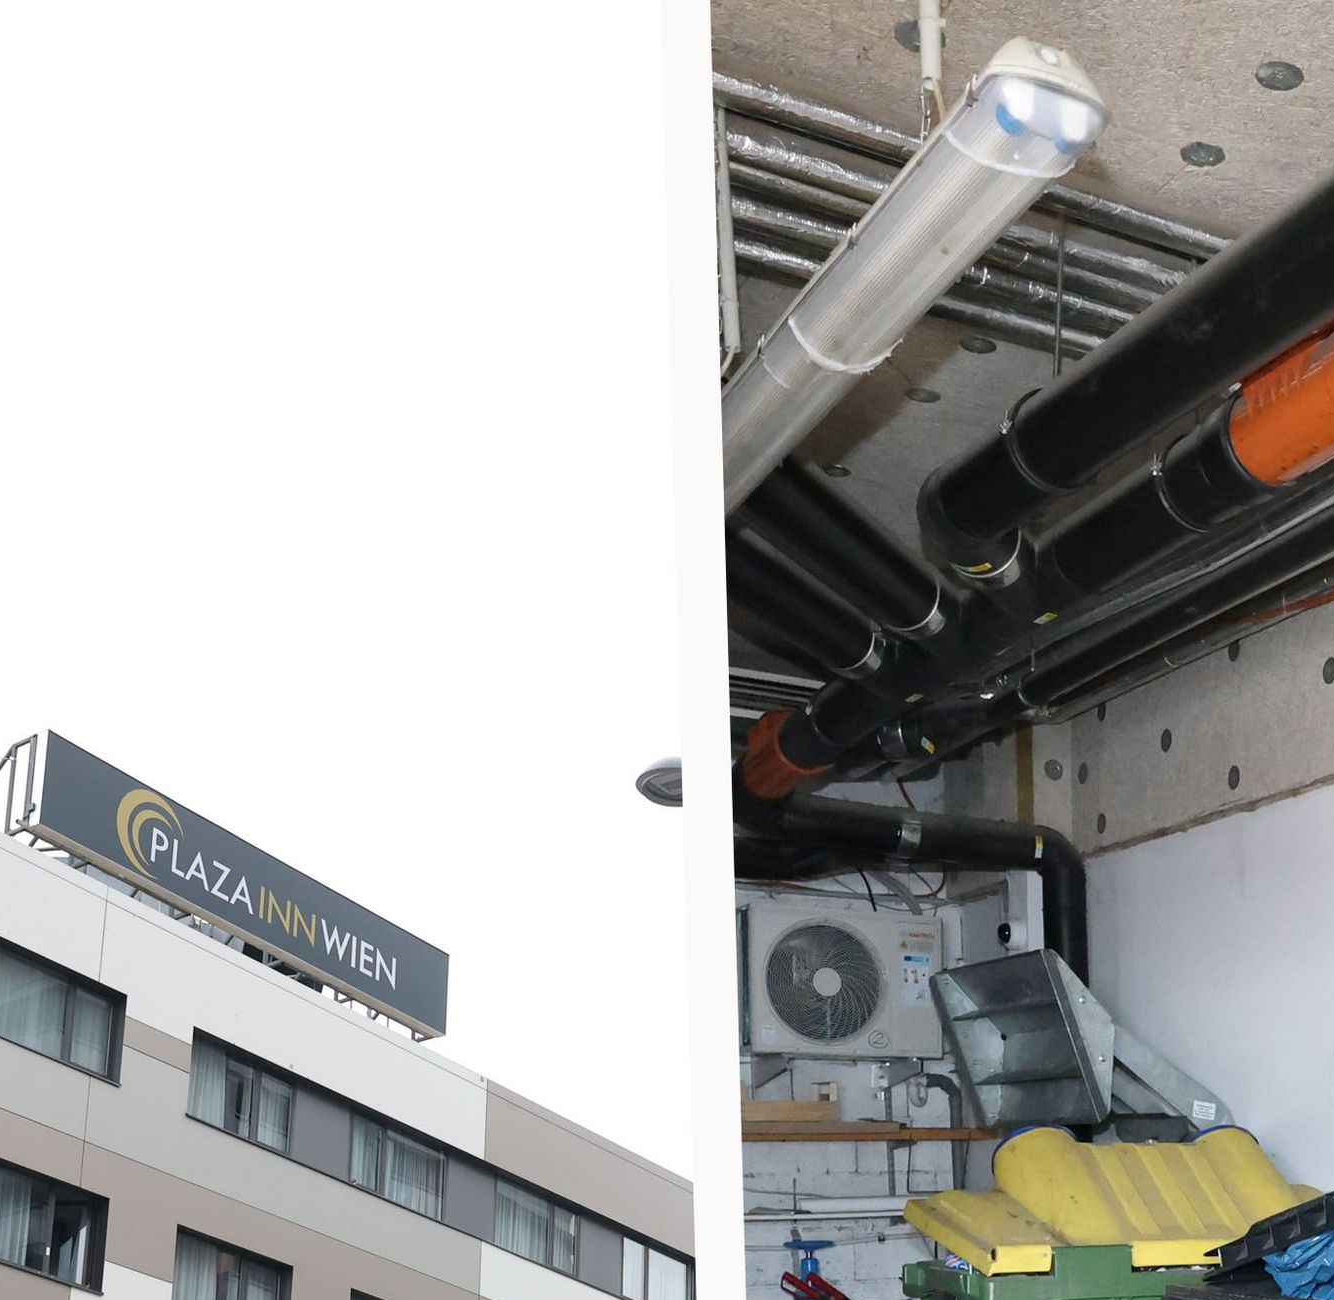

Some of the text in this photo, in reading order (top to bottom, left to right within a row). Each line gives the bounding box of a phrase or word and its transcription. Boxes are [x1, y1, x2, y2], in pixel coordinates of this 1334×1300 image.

[150, 827, 398, 991] PLAZA INN WIEN
